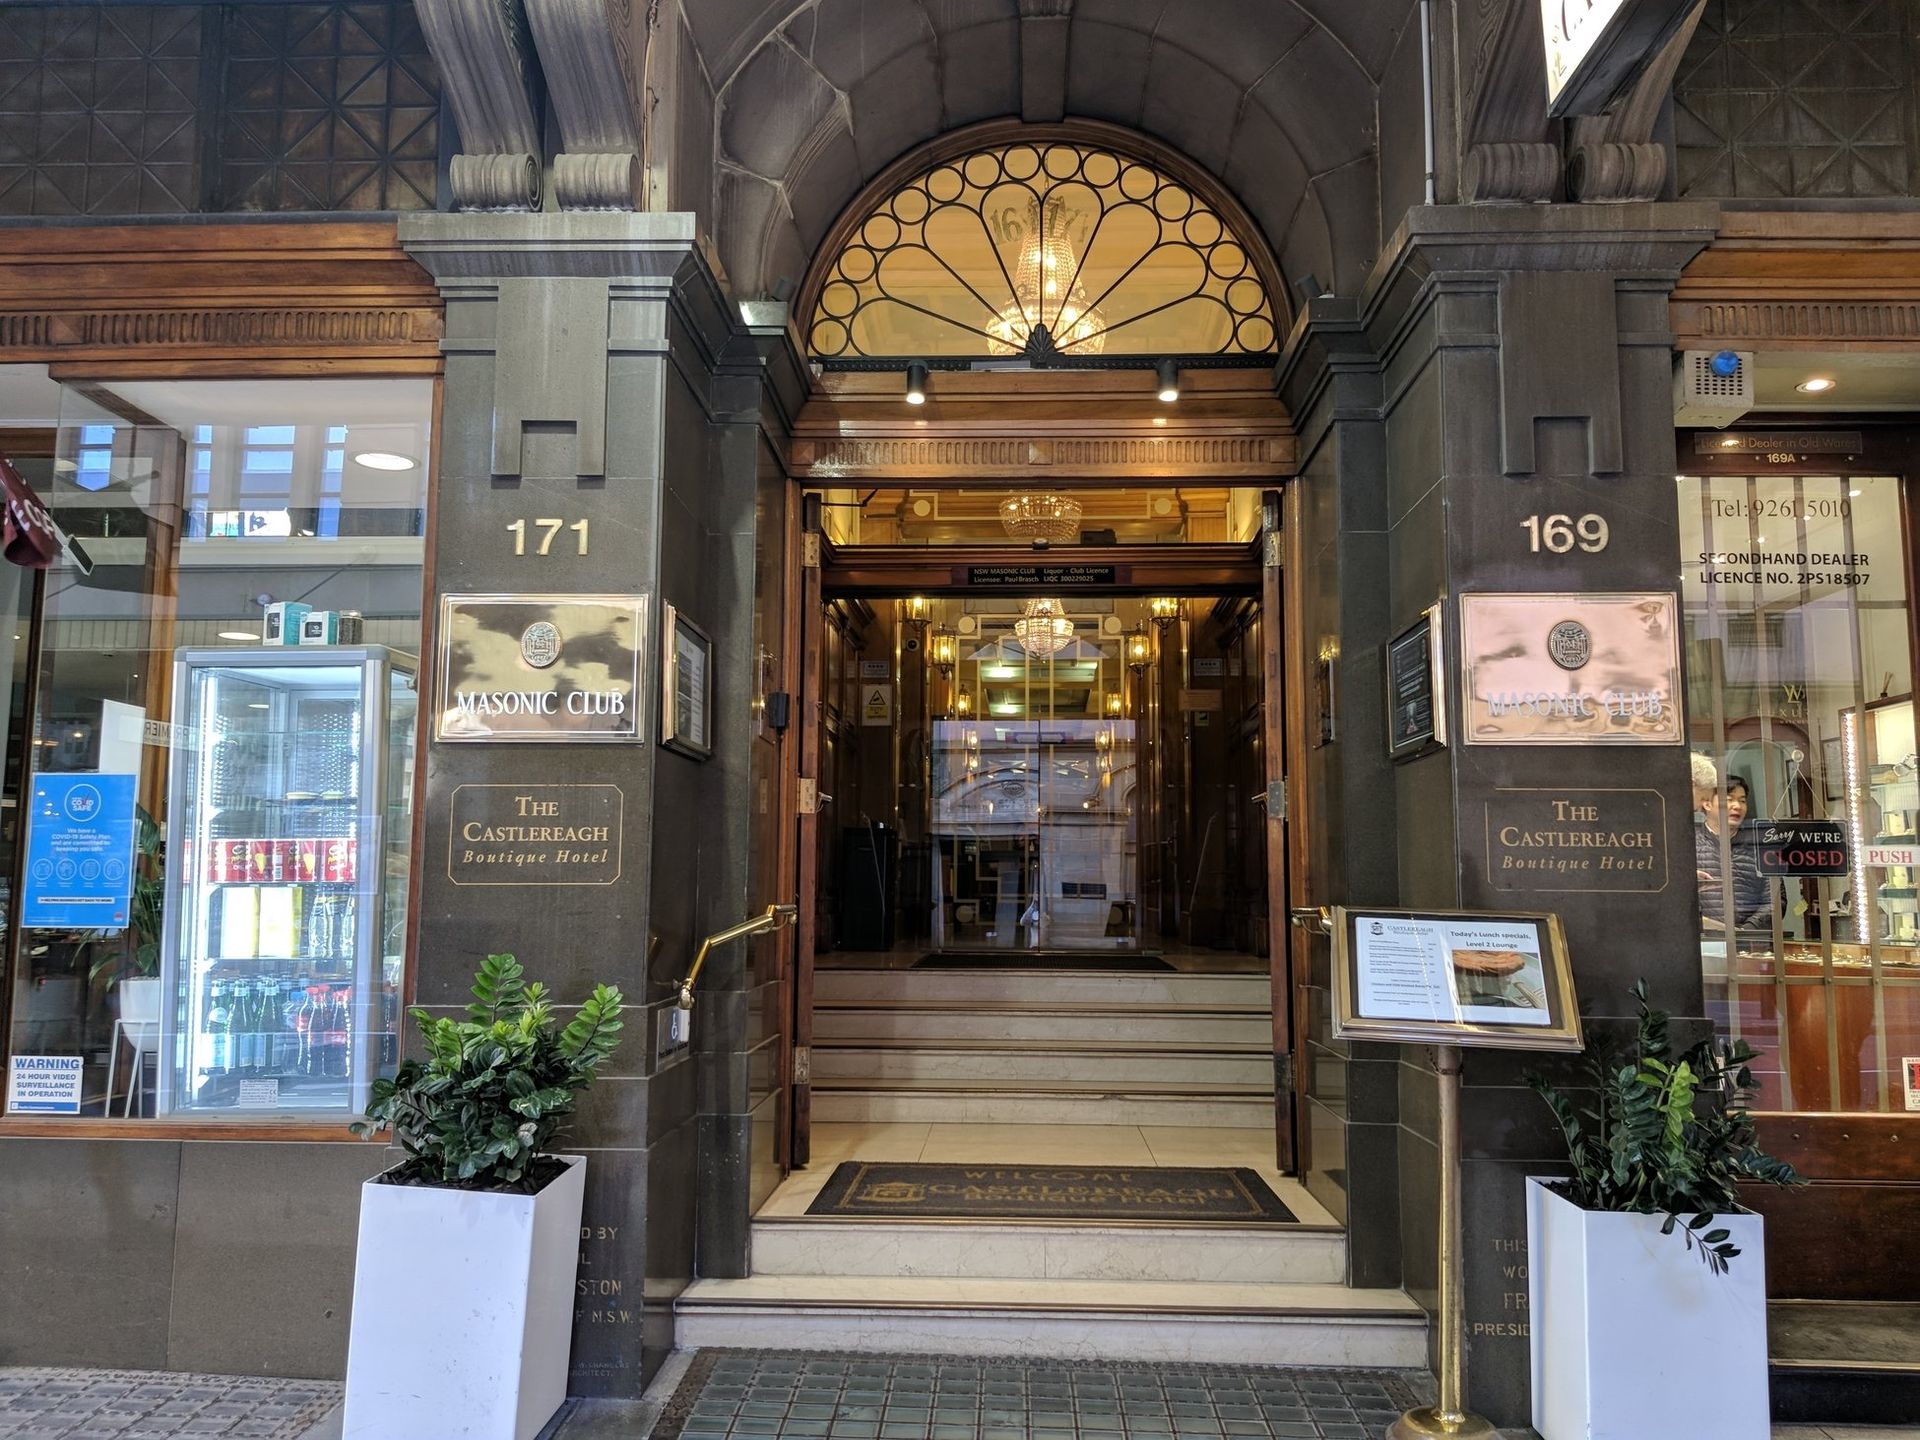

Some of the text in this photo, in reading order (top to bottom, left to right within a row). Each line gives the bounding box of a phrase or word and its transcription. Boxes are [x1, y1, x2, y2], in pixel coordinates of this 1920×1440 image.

[1748, 436, 1784, 449] Dealer
[1787, 437, 1796, 448] in
[1798, 437, 1822, 448] Old
[1767, 453, 1796, 463] 169A
[1711, 499, 1852, 518] Tel: 9261 5010
[506, 518, 590, 556] 171
[1520, 513, 1609, 553] 169
[1698, 552, 1869, 566] SECONDHAND DEALER
[1700, 572, 1870, 585] LICENCE NO. 2PS18507
[457, 690, 626, 716] MASONIC CLUB
[1486, 689, 1664, 717] MASONIC CLUB
[515, 796, 559, 817] THE
[1551, 800, 1599, 822] THE
[463, 821, 609, 843] CASTLEREAGH
[1499, 826, 1653, 848] CASTLEREAGH
[1762, 827, 1842, 844] Sorry WE'RE
[463, 848, 609, 867] Boutique Hotel
[1502, 855, 1654, 872] Boutique Hotel
[1763, 850, 1844, 867] CLOSED
[1868, 850, 1913, 864] PUSH
[15, 1058, 80, 1069] WARNING
[597, 1227, 619, 1240] BY
[1494, 1239, 1528, 1252] THIS
[592, 1310, 634, 1323] N.S.W.
